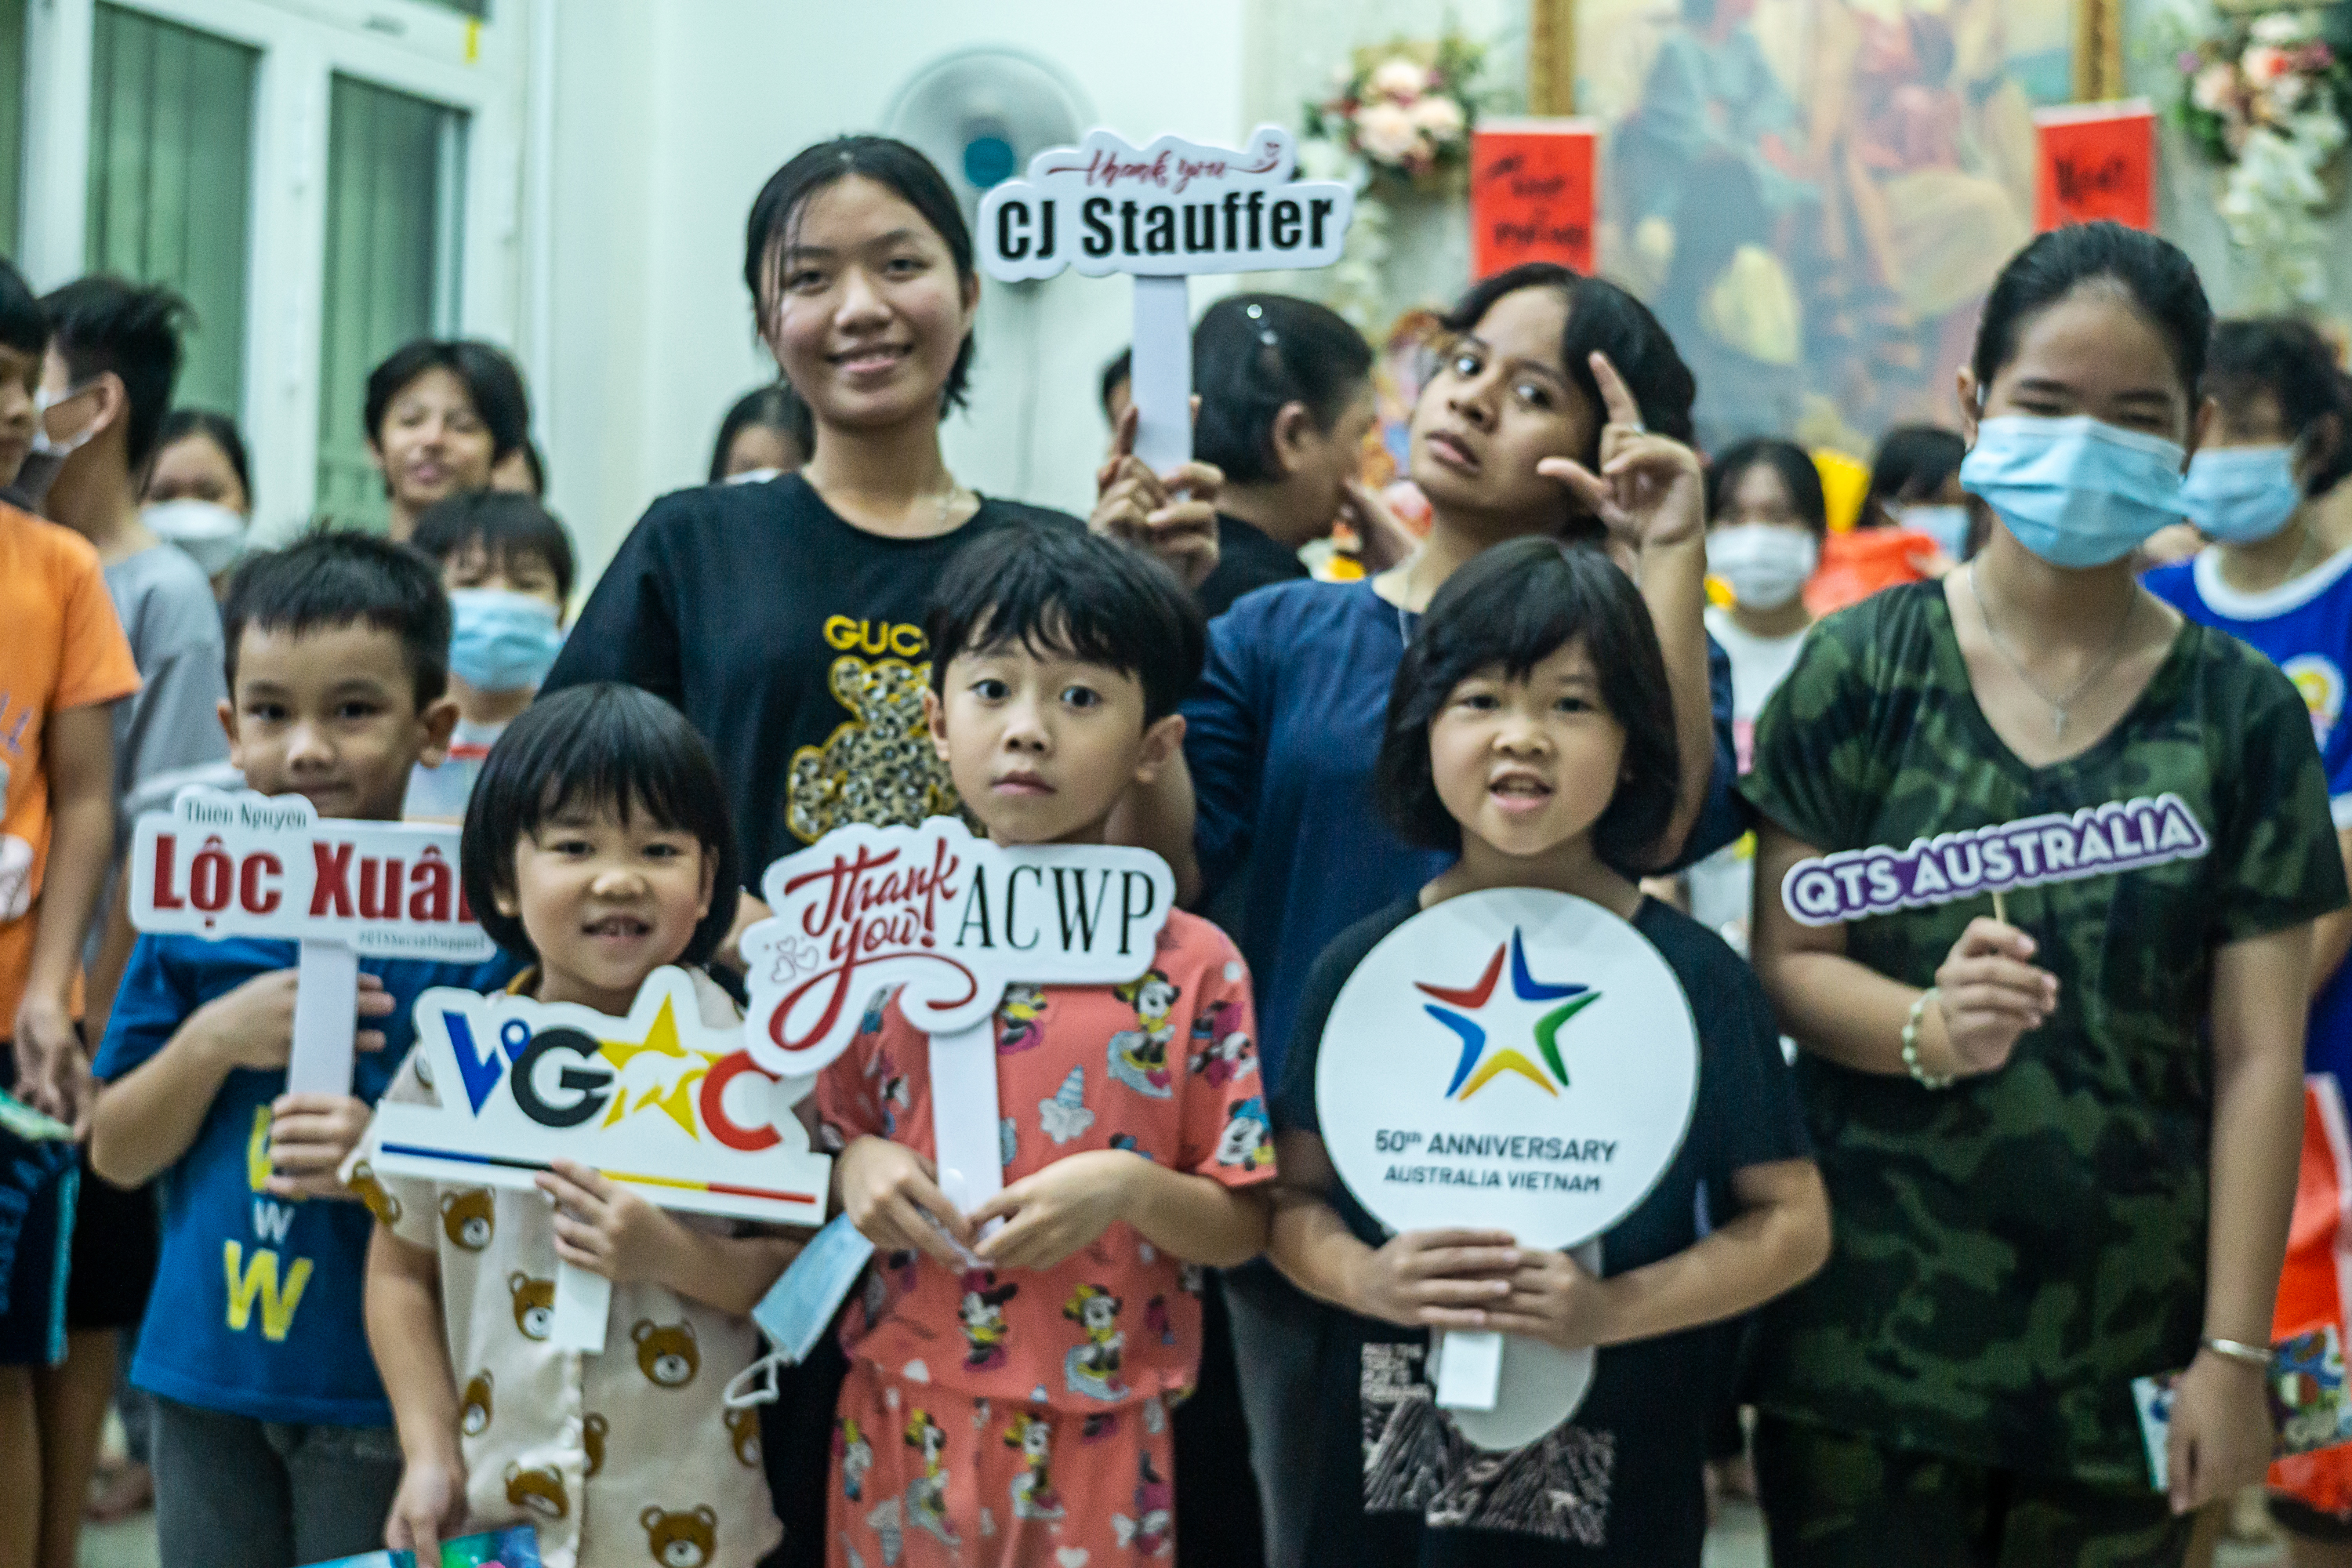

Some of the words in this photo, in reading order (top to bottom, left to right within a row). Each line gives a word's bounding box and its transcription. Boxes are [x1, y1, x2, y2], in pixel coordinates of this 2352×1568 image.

[998, 200, 1056, 261] CJ
[1081, 191, 1334, 257] Stauffer
[824, 615, 930, 657] GUC
[153, 833, 284, 928] Lộc
[1796, 858, 1900, 914] QTS
[1911, 801, 2194, 895] AUSTRALIA
[953, 862, 1156, 955] ACWP
[1375, 1128, 1423, 1153] 50th
[1427, 1132, 1619, 1163] ANNIVERSARY
[1383, 1163, 1502, 1188] AUSTRALIA
[1507, 1170, 1601, 1192] VIETNAM
[223, 1238, 314, 1342] W
